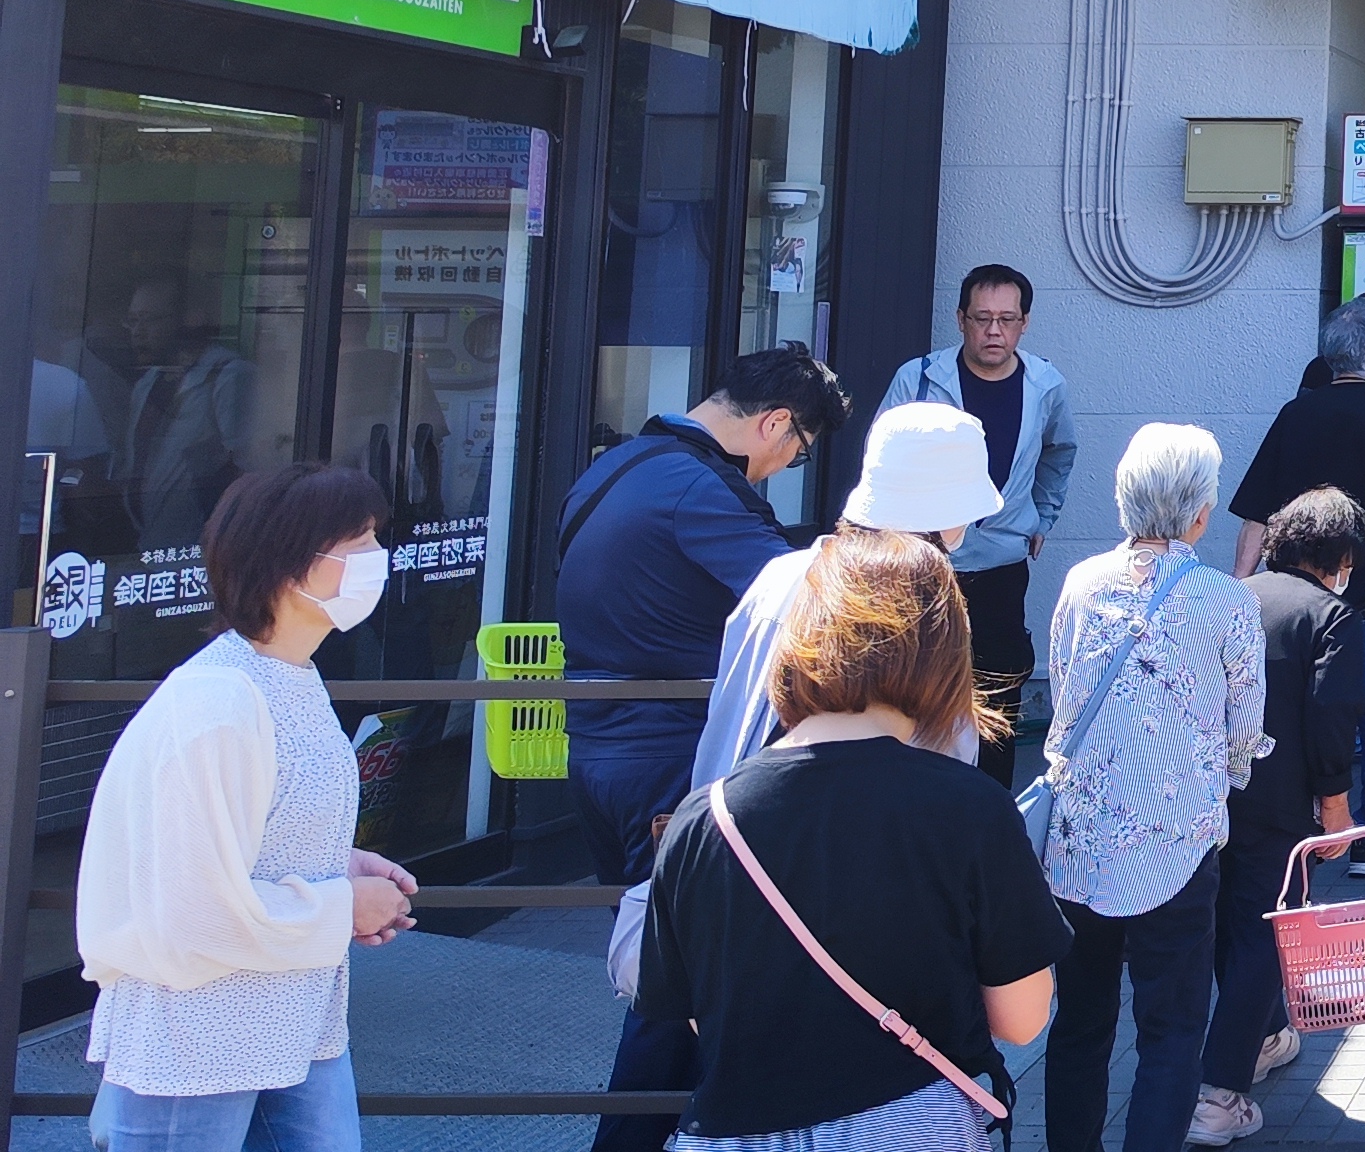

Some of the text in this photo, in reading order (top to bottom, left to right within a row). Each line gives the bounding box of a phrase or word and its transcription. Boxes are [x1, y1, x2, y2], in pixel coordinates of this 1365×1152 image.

[392, 535, 486, 572] 銀座惣菜
[49, 613, 77, 630] DELI
